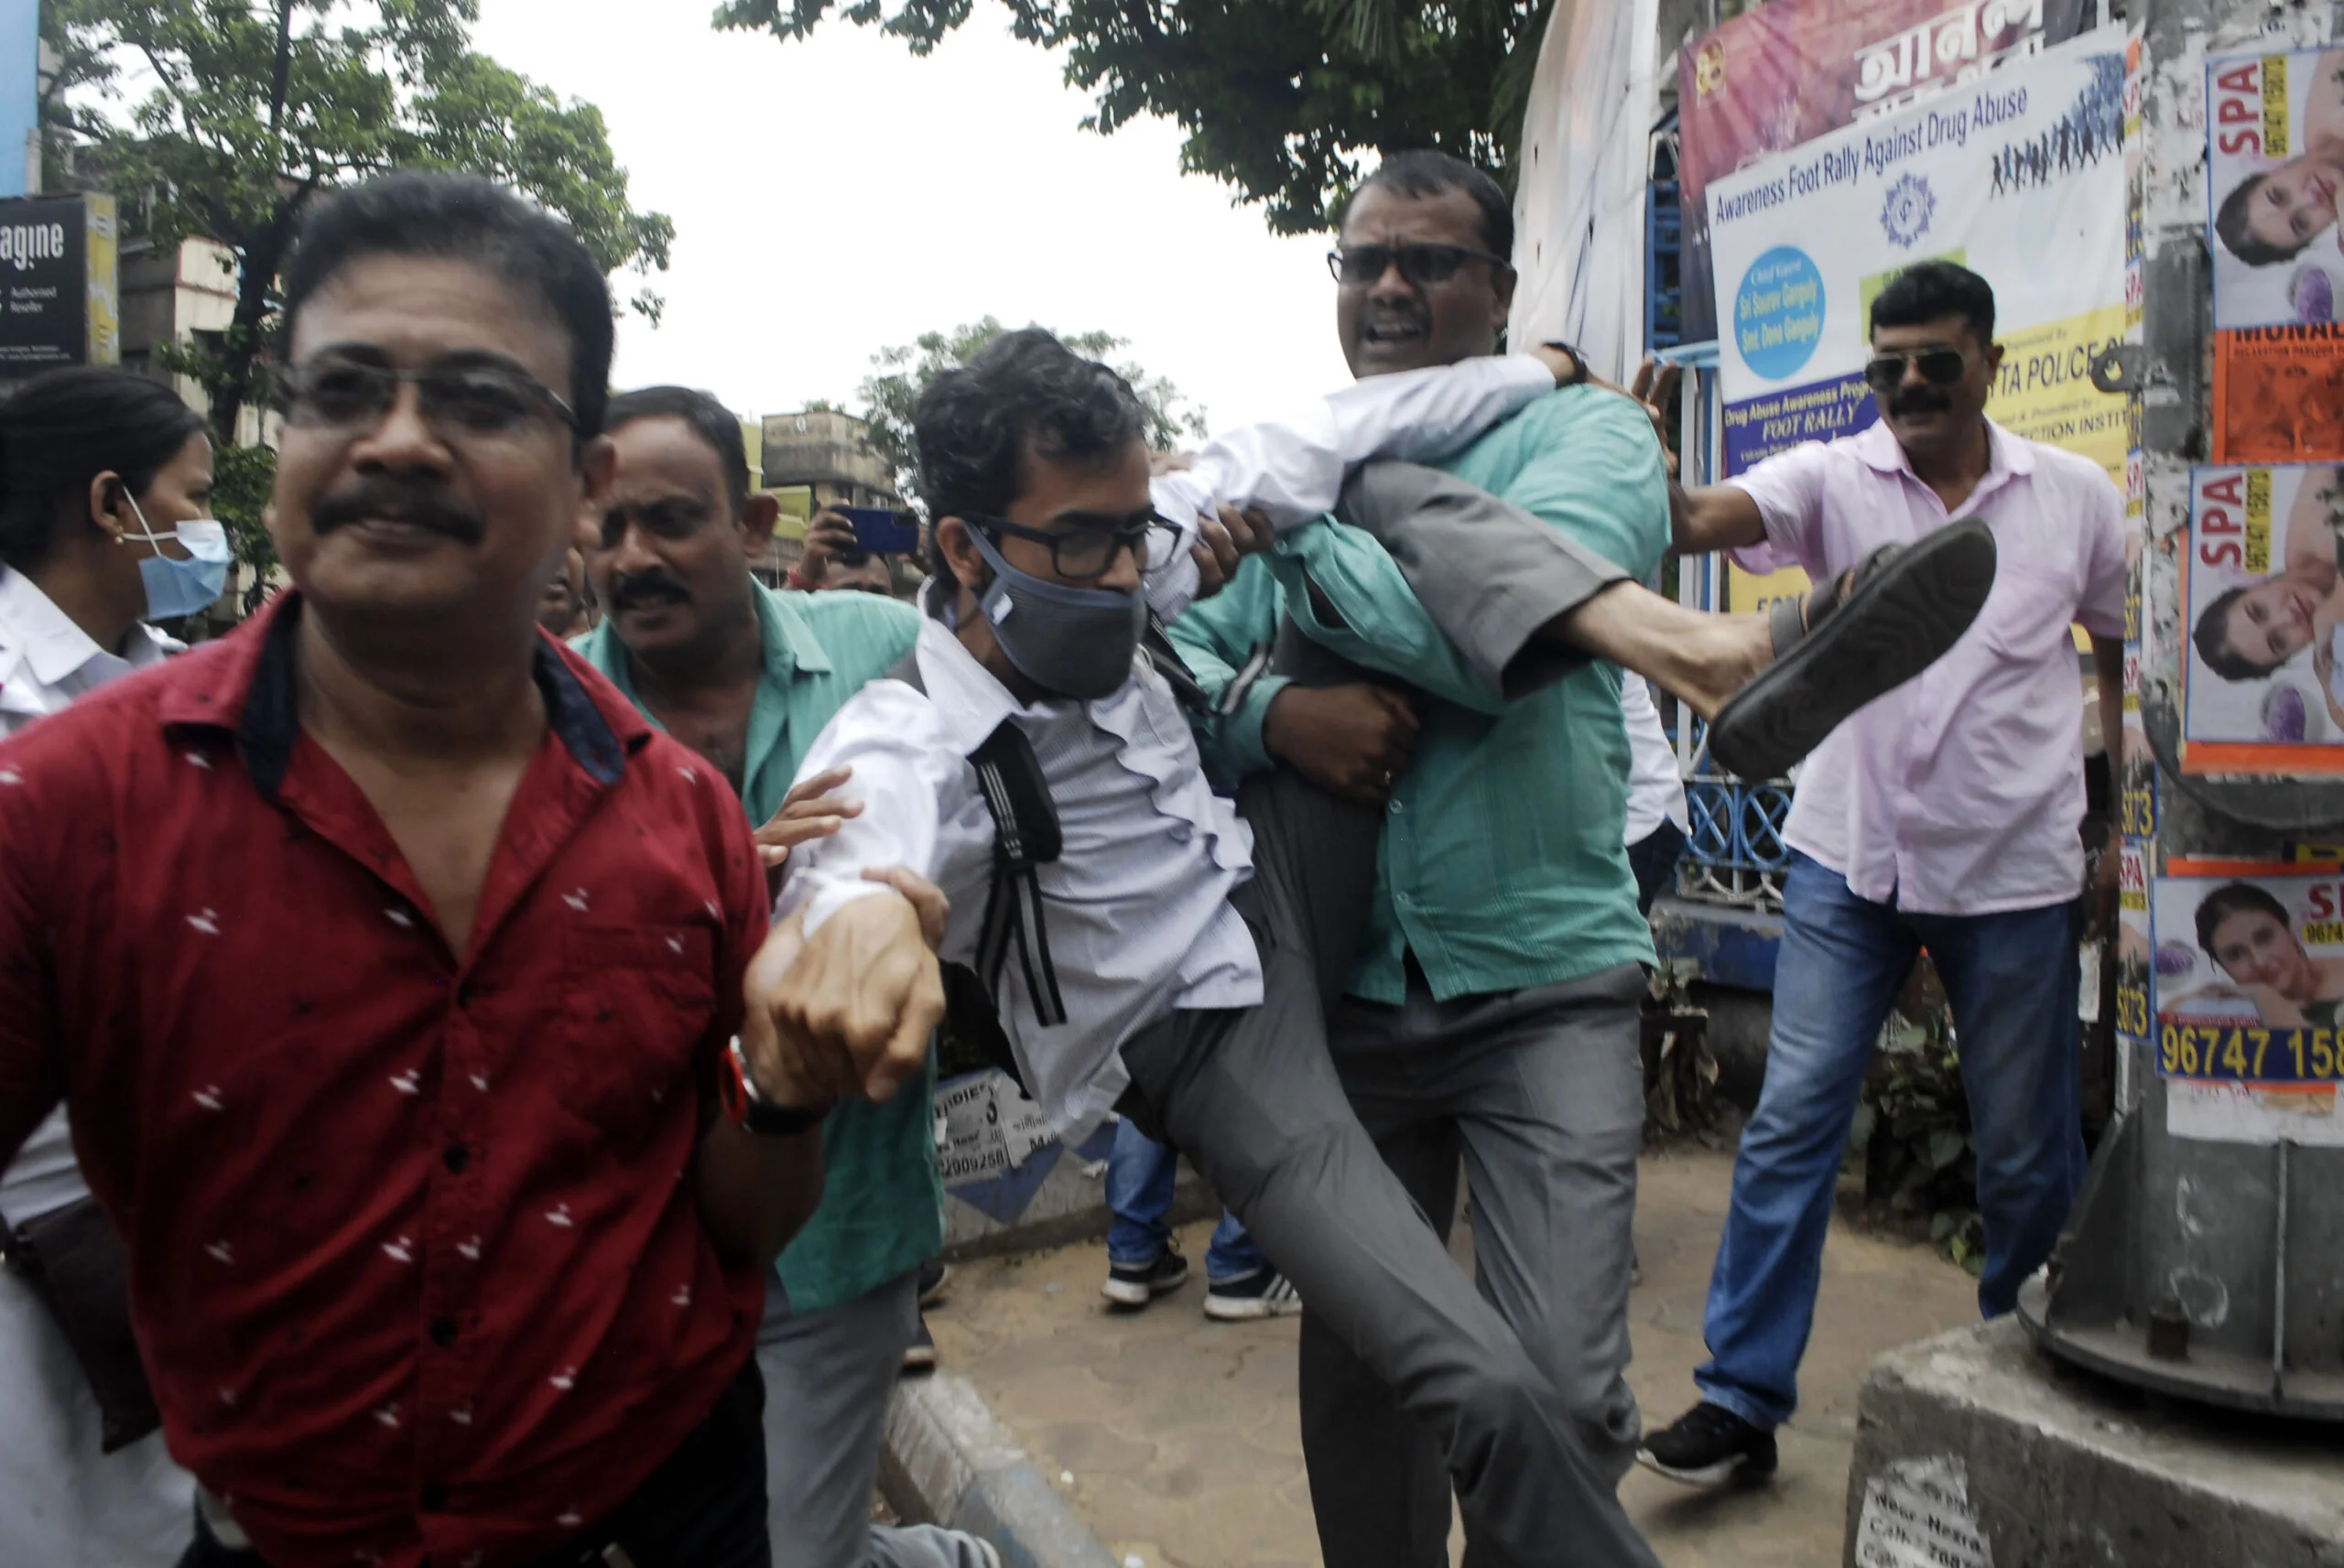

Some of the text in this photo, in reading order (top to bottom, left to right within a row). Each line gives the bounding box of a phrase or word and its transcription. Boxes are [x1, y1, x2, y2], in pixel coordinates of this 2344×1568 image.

[2218, 61, 2260, 156] SPA
[1716, 178, 1785, 226] Awareness
[1788, 161, 1820, 200] Foot
[1823, 144, 1860, 186] Rally
[1864, 120, 1924, 177] Against
[1927, 109, 1968, 148] Drug
[1971, 86, 2028, 132] Abuse
[1724, 407, 1749, 427] Drug
[1749, 401, 1781, 422] Abuse
[1782, 387, 1839, 414] Awareness
[1763, 398, 1861, 443] FOOT RALLY
[2200, 472, 2243, 568] SPA
[2162, 1022, 2271, 1076] 96747
